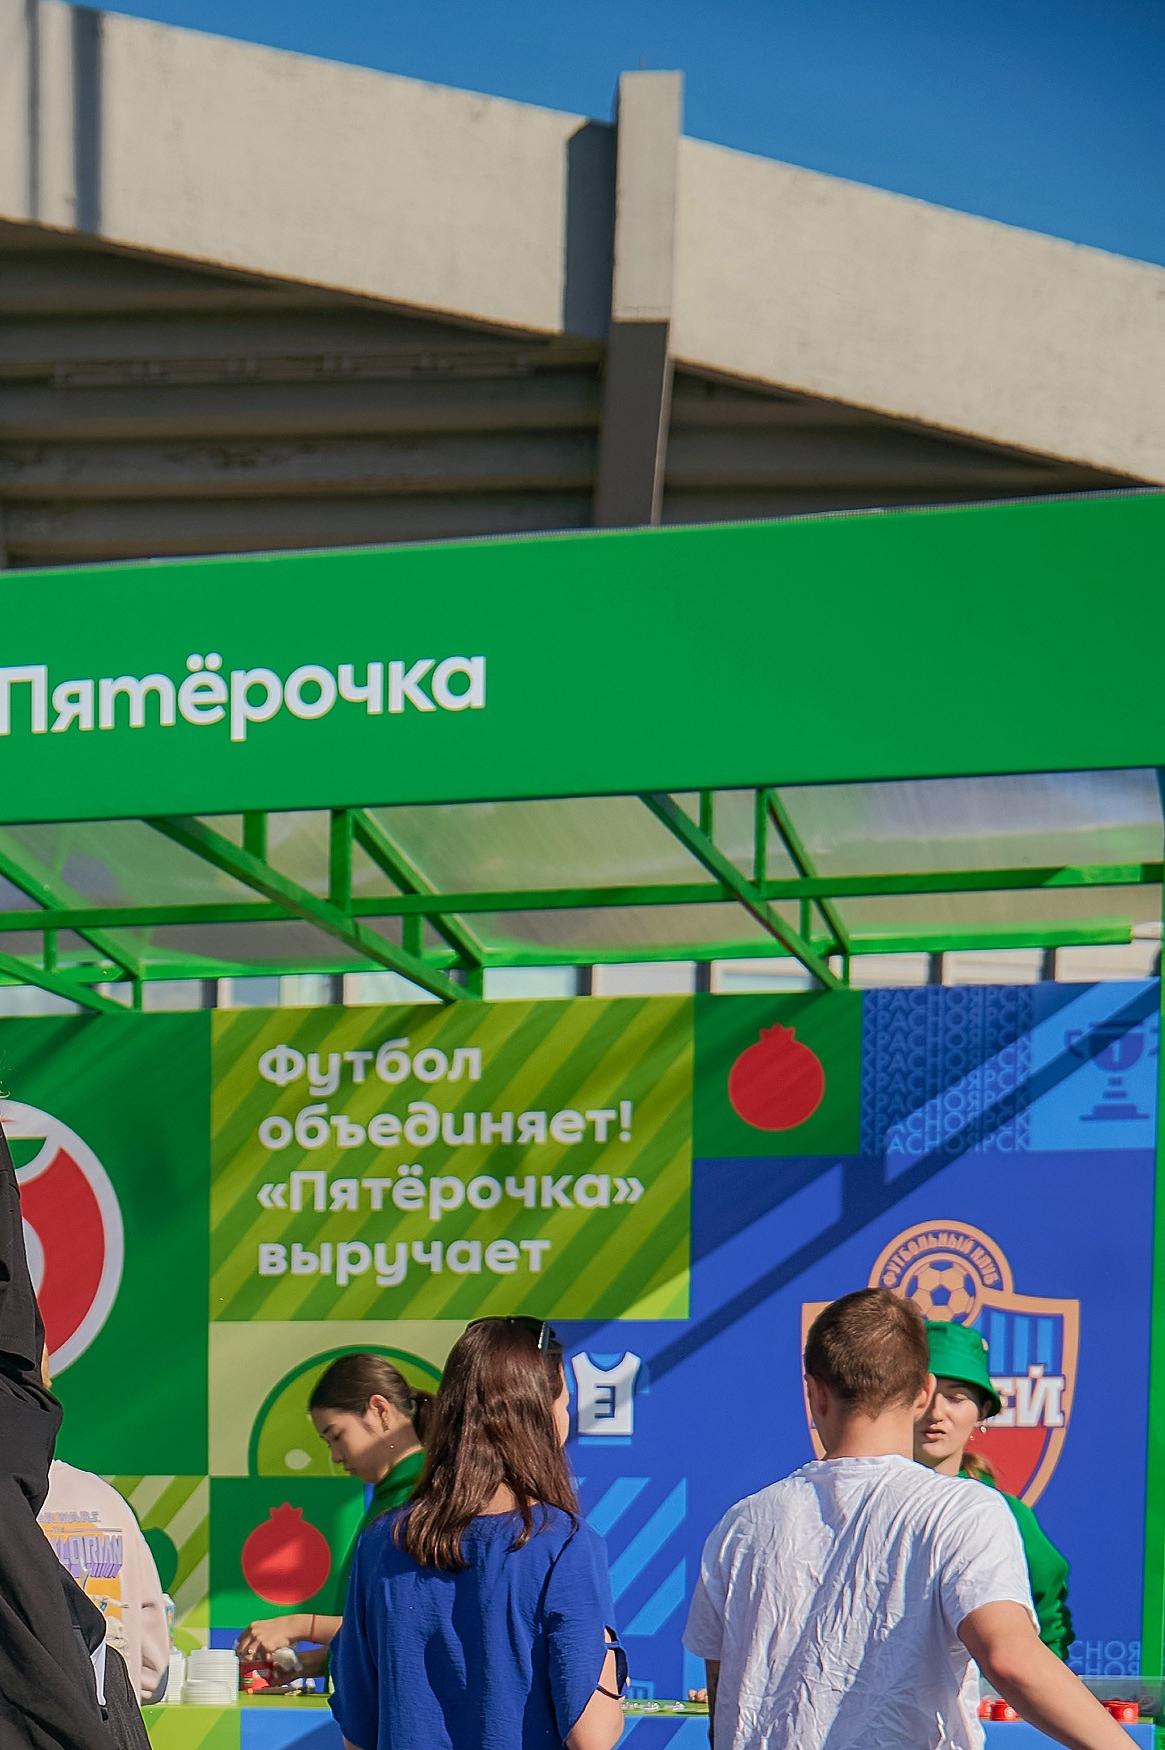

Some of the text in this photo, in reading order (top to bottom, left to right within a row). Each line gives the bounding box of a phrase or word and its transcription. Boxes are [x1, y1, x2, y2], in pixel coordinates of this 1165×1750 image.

[258, 1037, 482, 1096] Футбол
[258, 1100, 633, 1150] объединяет!
[256, 1164, 645, 1221] «Пятёрочка»
[258, 1238, 552, 1288] выручает
[883, 1232, 1000, 1286] ФУТБОЛЬНЫЙ КЛУБ
[977, 1364, 1065, 1428] ЕЙ
